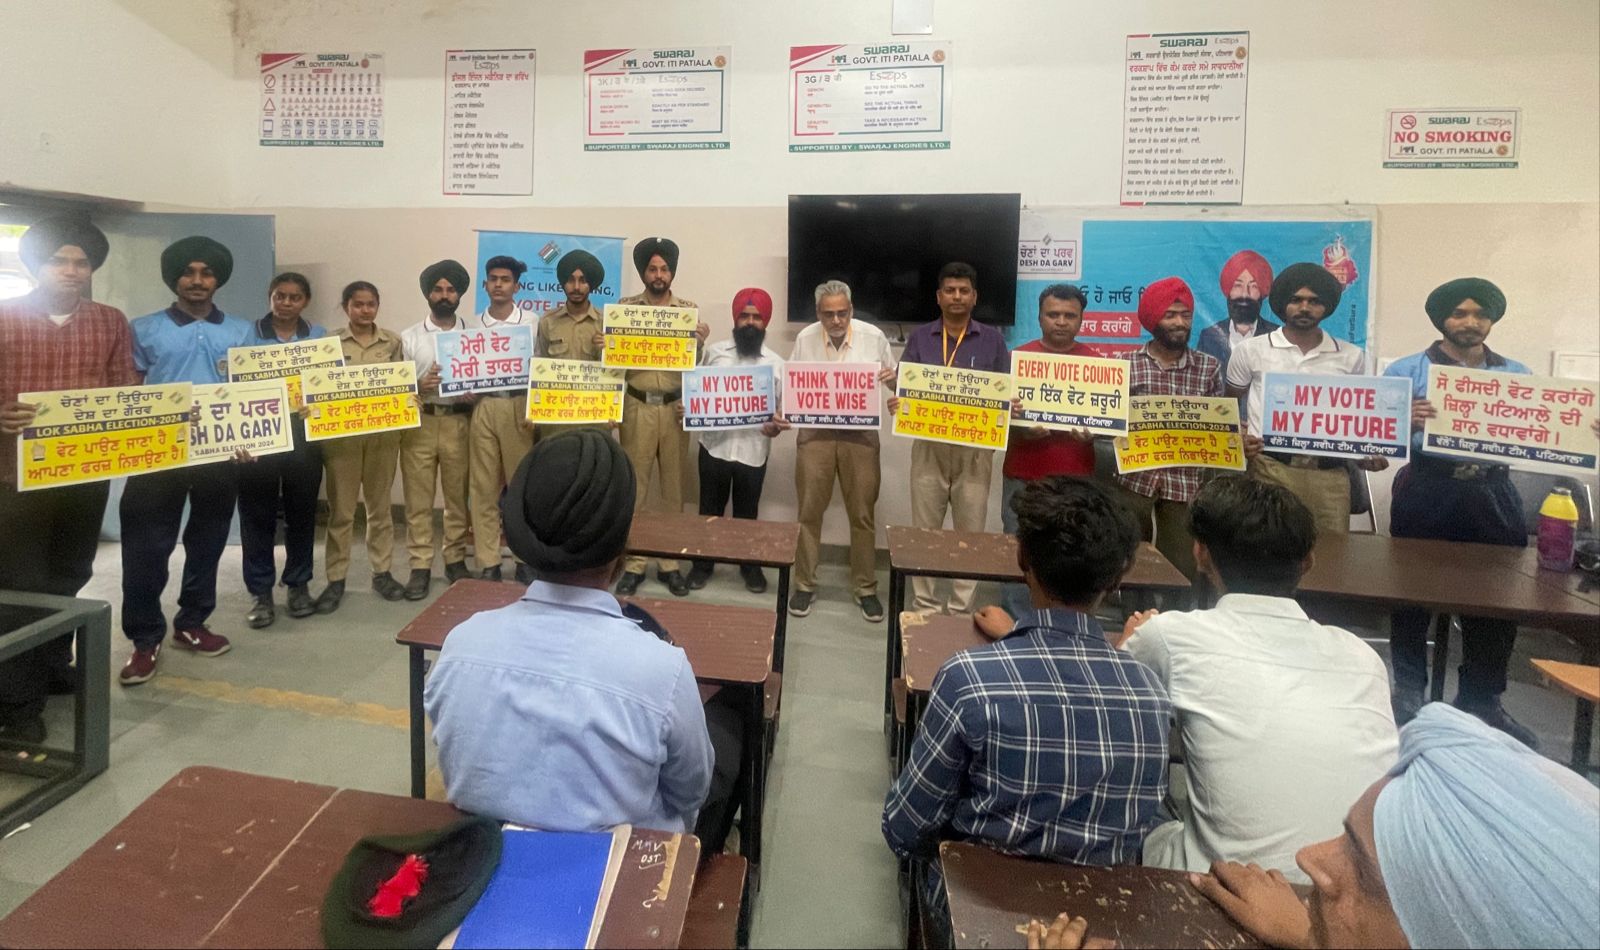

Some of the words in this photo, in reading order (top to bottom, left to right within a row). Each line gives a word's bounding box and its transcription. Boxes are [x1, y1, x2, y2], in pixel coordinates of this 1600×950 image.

[653, 50, 695, 58] SWARAJ
[864, 45, 910, 54] SWARAJ
[642, 60, 666, 68] GOVT.
[853, 56, 878, 64] GOVT.
[893, 54, 930, 62] PATIALA
[1393, 131, 1419, 143] NO
[1425, 130, 1512, 143] SMOKING
[1459, 146, 1494, 154] PATIALA
[1040, 248, 1050, 258] ਦਾ
[538, 282, 563, 292] LIKE
[1109, 286, 1132, 304] ਜਾਓ
[461, 332, 486, 355] ਮੇਰੀ
[490, 330, 510, 352] ਵੋਟ
[451, 356, 479, 378] ਮੇਰੀ
[485, 357, 523, 376] ਤਾਕਤ
[943, 372, 952, 380] ਦਾ
[1018, 359, 1050, 380] EVERY
[1054, 362, 1080, 382] VOTE
[1083, 364, 1124, 386] COUNTS
[702, 376, 719, 392] MY
[724, 375, 754, 392] VOTE
[788, 370, 828, 389] THINK
[834, 371, 874, 390] TWICE
[946, 384, 956, 392] ਦਾ
[60, 395, 88, 408] ਚੋਣਾਂ
[95, 395, 110, 405] ਦਾ
[117, 390, 164, 405] ਤਿਉਹਾਰ
[314, 394, 328, 402] LOK
[330, 391, 356, 400] SABHA
[357, 386, 410, 398] ELECTION-2024
[797, 392, 830, 408] VOTE
[835, 392, 867, 410] WISE
[906, 390, 920, 399] LOK
[922, 392, 946, 402] SABHA
[948, 394, 1002, 409] ELECTION-2024
[1018, 386, 1036, 401] ਹਰ
[1040, 382, 1063, 404] ਇੱਕ
[1068, 384, 1086, 406] ਵੋਟ
[1295, 384, 1322, 406] MY
[1329, 386, 1376, 410] VOTE
[1455, 376, 1501, 396] ਫੀਸਦੀ
[1508, 380, 1534, 400] ਵੋਟ
[1542, 387, 1595, 408] ਕਰਾਂਗੇ
[102, 408, 118, 418] ਦਾ
[124, 404, 152, 416] ਗੌਰਵ
[210, 402, 231, 420] ਦਾ
[239, 398, 280, 418] ਪਰਵ
[690, 397, 710, 414] MY
[715, 394, 768, 414] FUTURE
[916, 404, 928, 417] ਵੋਟ
[1484, 400, 1550, 423] ਪਟਿਆਲੇ
[1560, 408, 1582, 426] ਦੀ
[36, 427, 62, 438] LOK
[64, 424, 102, 436] SABHA
[106, 414, 182, 432] ELECTION-2024
[190, 426, 208, 446] SH
[214, 422, 236, 443] DA
[240, 416, 281, 439] GARV
[1272, 410, 1304, 432] MY
[1312, 412, 1397, 440] FUTURE
[1452, 419, 1480, 435] ਸ਼ਾਨ
[56, 441, 78, 458] ਵੋਟ
[84, 437, 120, 456] ਪਾਉਣ
[126, 435, 153, 450] ਜਾਣਾ
[158, 428, 168, 446] ਹੈ
[195, 447, 220, 456] SABHA
[222, 443, 256, 453] ELECTION
[258, 440, 274, 448] 2024
[28, 463, 76, 480] ਆਪਣਾ
[118, 449, 168, 469] ਨਿਭਾਉਣਾ
